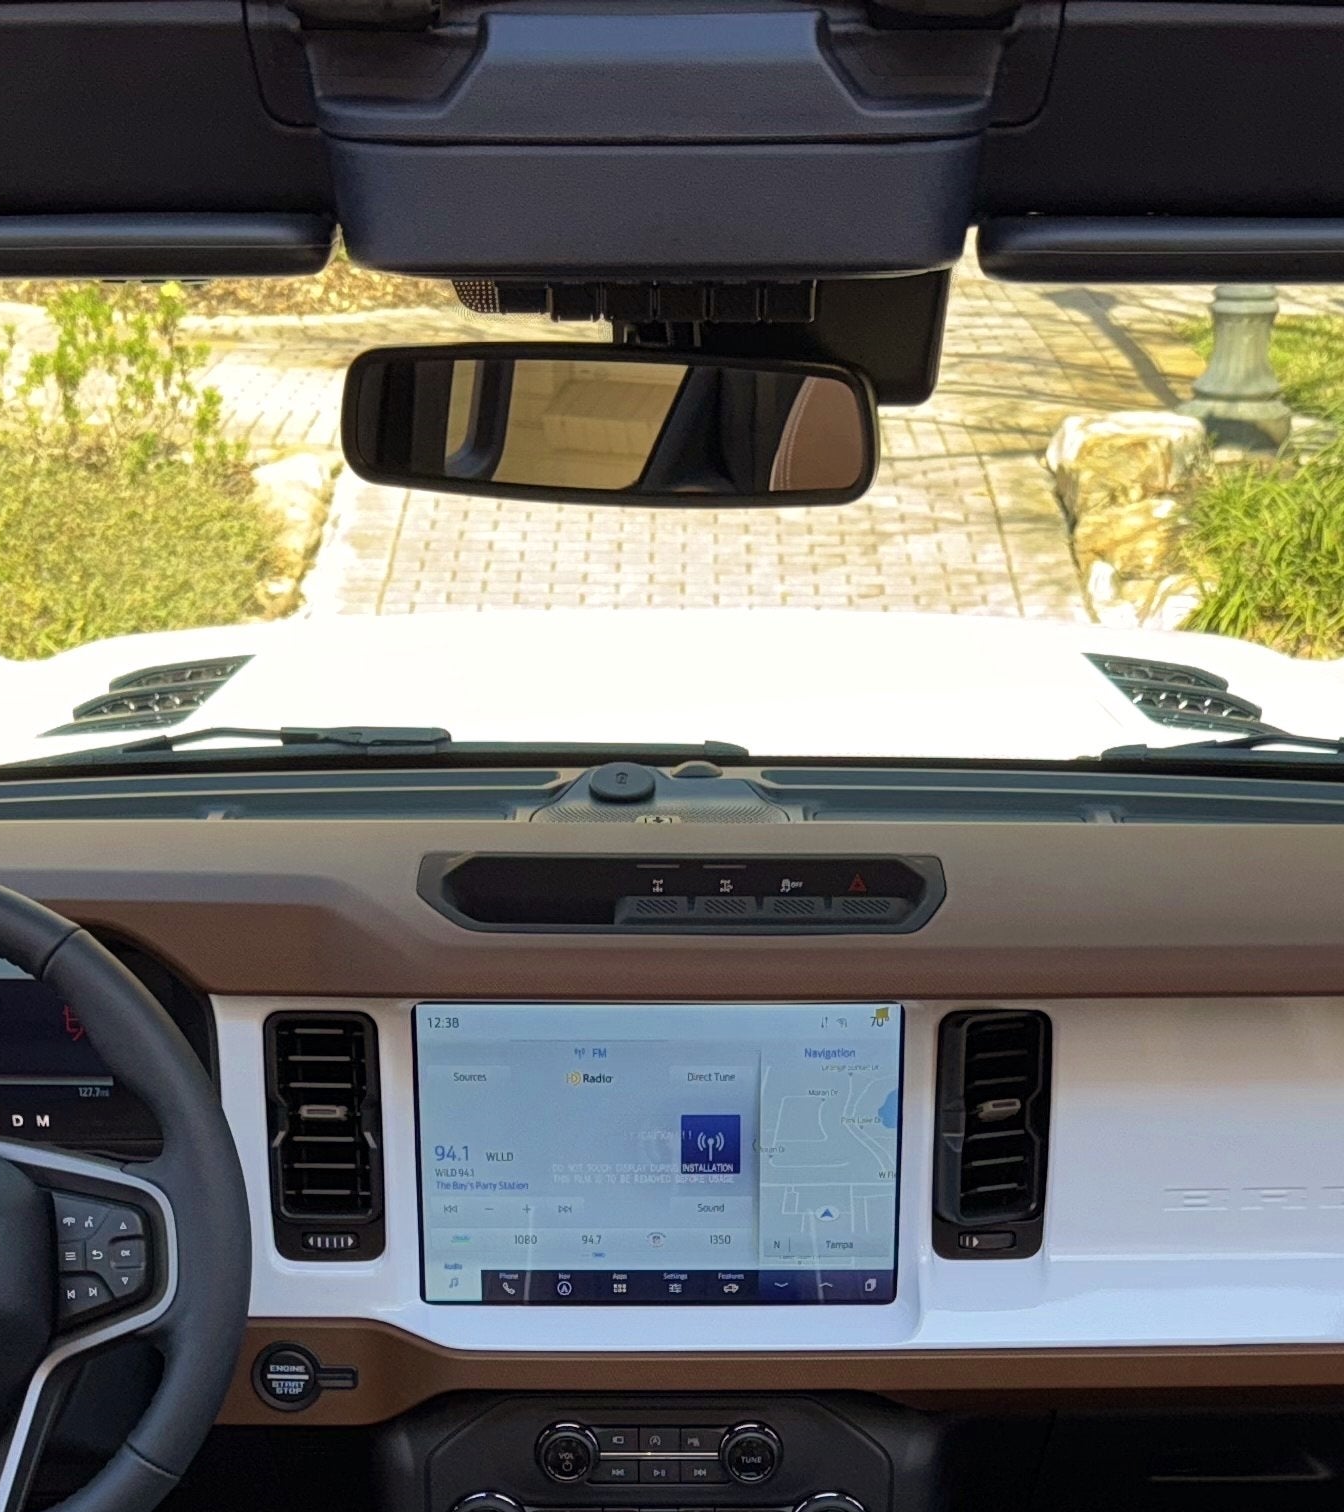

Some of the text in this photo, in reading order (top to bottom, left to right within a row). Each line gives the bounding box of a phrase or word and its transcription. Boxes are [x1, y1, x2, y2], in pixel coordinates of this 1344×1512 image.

[427, 1017, 460, 1029] 12:38
[592, 1048, 607, 1059] FM
[804, 1047, 856, 1060] Navigation
[453, 1072, 487, 1082] Sources
[582, 1072, 613, 1084] Radio
[687, 1072, 736, 1082] Direct Tune
[11, 1114, 24, 1127] D
[36, 1114, 50, 1127] M
[434, 1144, 514, 1162] 94.1 WLLD
[682, 1163, 734, 1173] INSTALLATION
[436, 1180, 451, 1190] The
[476, 1180, 497, 1191] Party
[498, 1181, 529, 1190] Station
[697, 1202, 725, 1213] Sound
[514, 1234, 538, 1245] 1080
[581, 1234, 602, 1245] 94.7
[709, 1234, 731, 1245] 1350
[773, 1239, 854, 1250] N Tampa
[558, 1272, 571, 1280] Nav
[269, 1365, 306, 1373] ENGINE
[275, 1387, 303, 1395] STOP
[558, 1452, 574, 1460] VOL
[741, 1456, 762, 1464] TUNE
